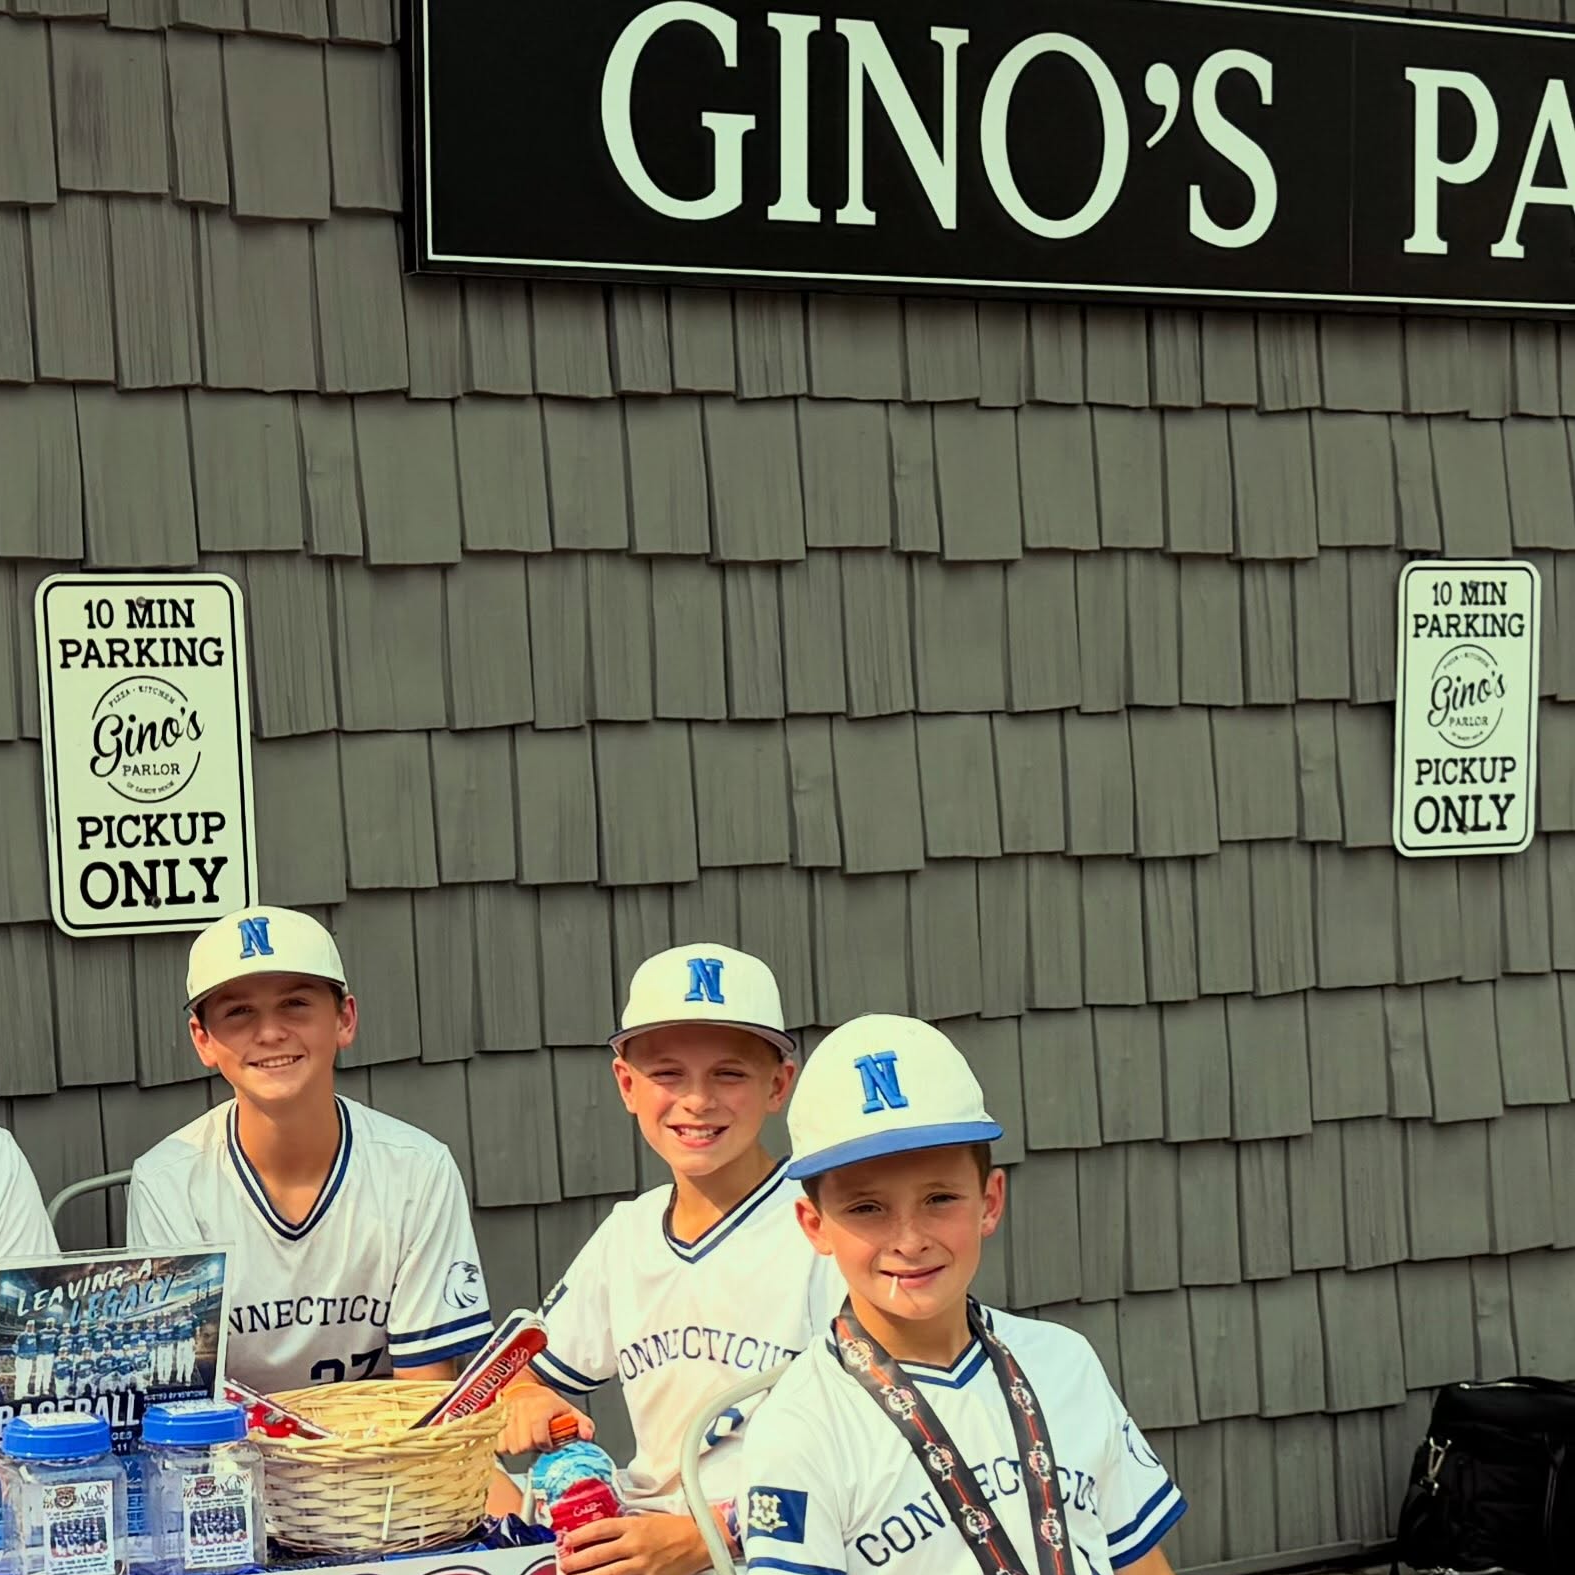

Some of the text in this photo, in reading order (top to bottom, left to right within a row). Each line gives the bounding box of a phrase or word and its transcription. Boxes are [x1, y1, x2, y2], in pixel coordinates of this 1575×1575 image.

[84, 598, 196, 629] 10 MIN
[1432, 580, 1508, 606] 10 MIN
[1413, 613, 1525, 639] PARKING
[59, 637, 225, 669] PARKING
[90, 706, 205, 777] Gino's
[122, 763, 180, 777] PARLOR
[1415, 756, 1517, 785] PICKUP
[77, 811, 226, 850] PICKUP
[1414, 793, 1516, 835] ONLY
[80, 856, 229, 910] ONLY
[236, 915, 276, 959] N
[684, 957, 725, 1004] N
[853, 1050, 910, 1115] N
[16, 1258, 152, 1317] LEAVING A
[69, 1272, 176, 1327] LEGACY
[228, 1295, 391, 1335] NNECTICU
